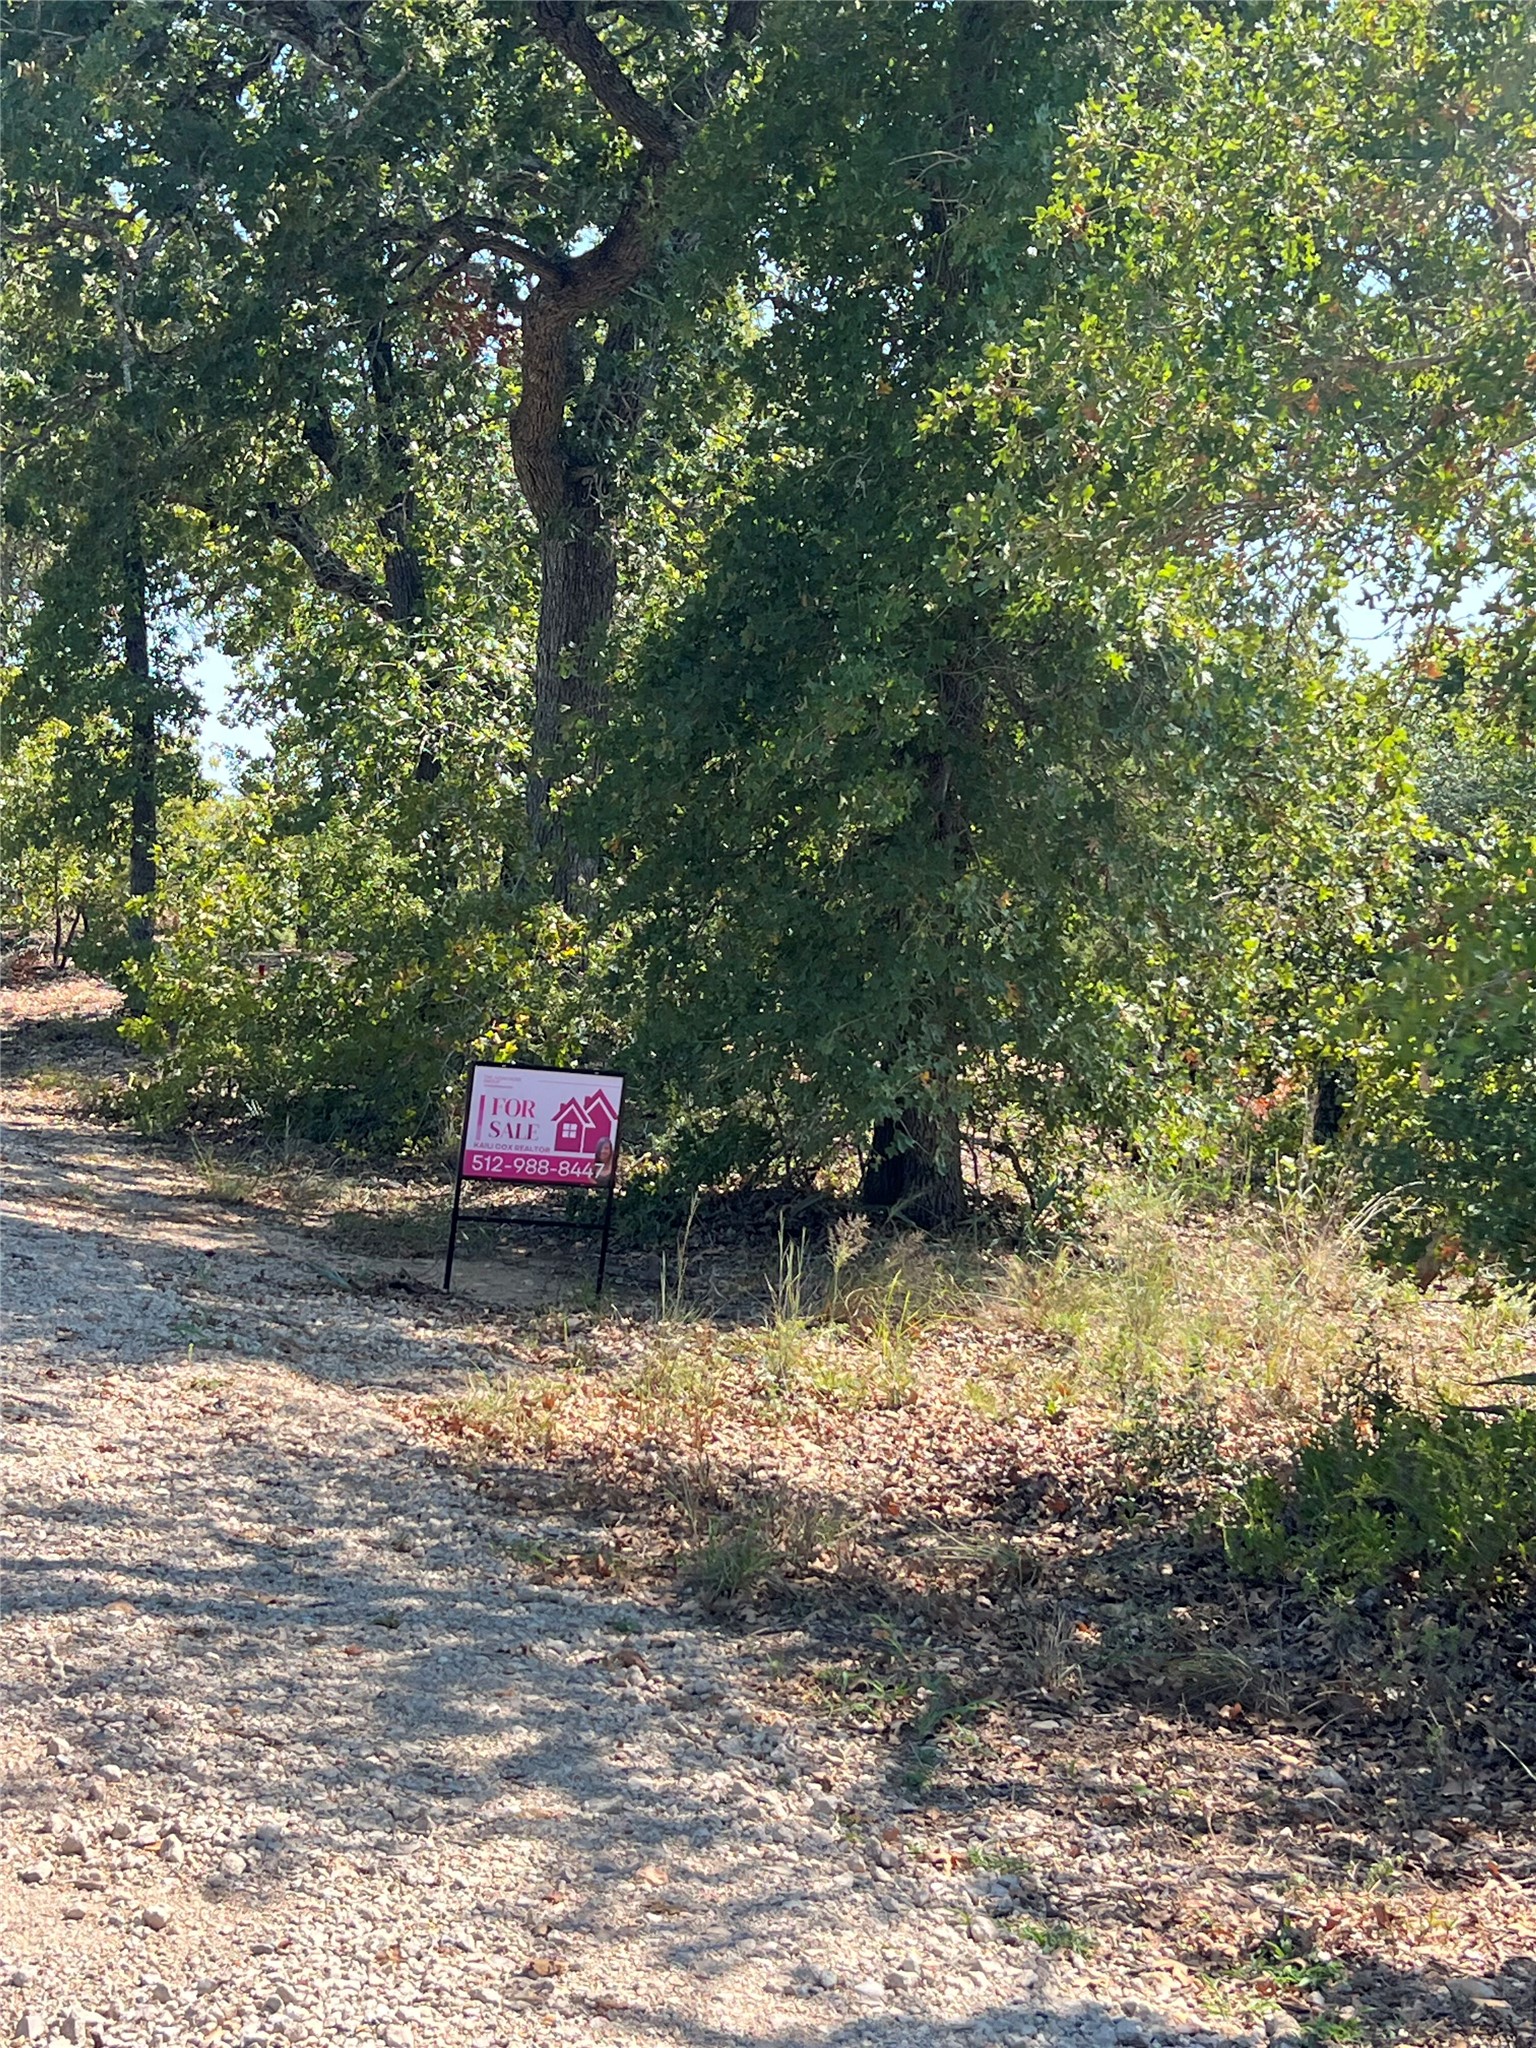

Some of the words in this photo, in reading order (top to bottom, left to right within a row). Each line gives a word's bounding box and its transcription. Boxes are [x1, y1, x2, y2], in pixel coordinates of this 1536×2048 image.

[492, 1097, 536, 1118] FOR
[488, 1120, 540, 1141] SALE
[495, 1143, 513, 1151] COX
[514, 1144, 551, 1154] REALTOR
[471, 1154, 605, 1179] 512-988-8447
